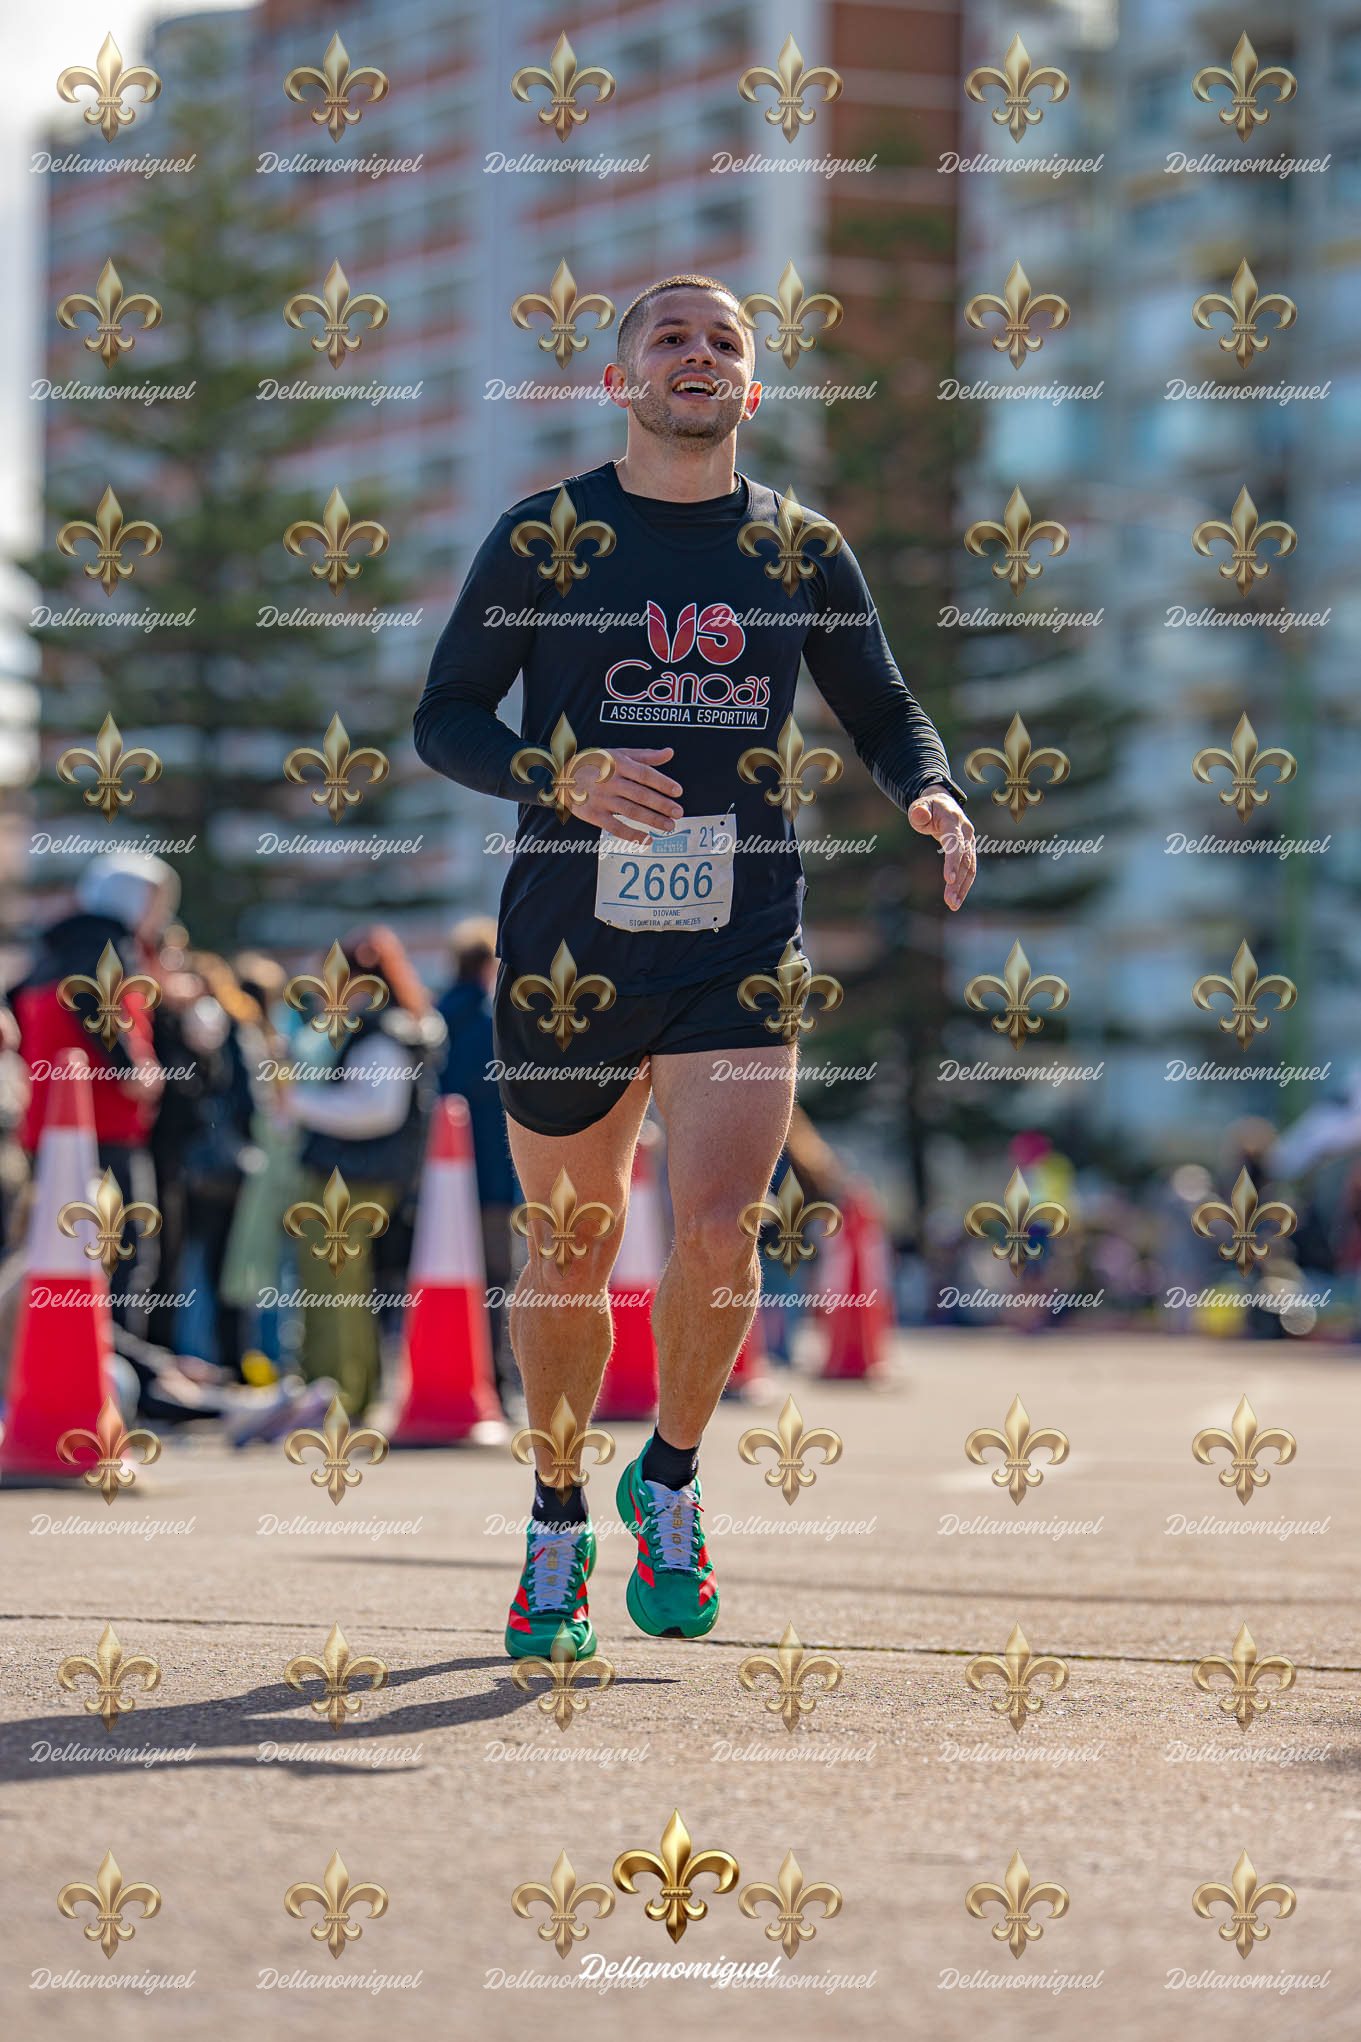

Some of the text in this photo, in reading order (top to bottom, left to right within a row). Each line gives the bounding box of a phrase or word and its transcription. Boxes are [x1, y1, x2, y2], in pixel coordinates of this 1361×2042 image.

[605, 659, 770, 707] Canoas
[610, 706, 758, 725] ASSESSORIA ESPORTIVA
[618, 861, 713, 901] 2666
[653, 909, 681, 917] DIOVANE
[629, 919, 661, 927] SIQUEIRA
[663, 919, 673, 927] DE
